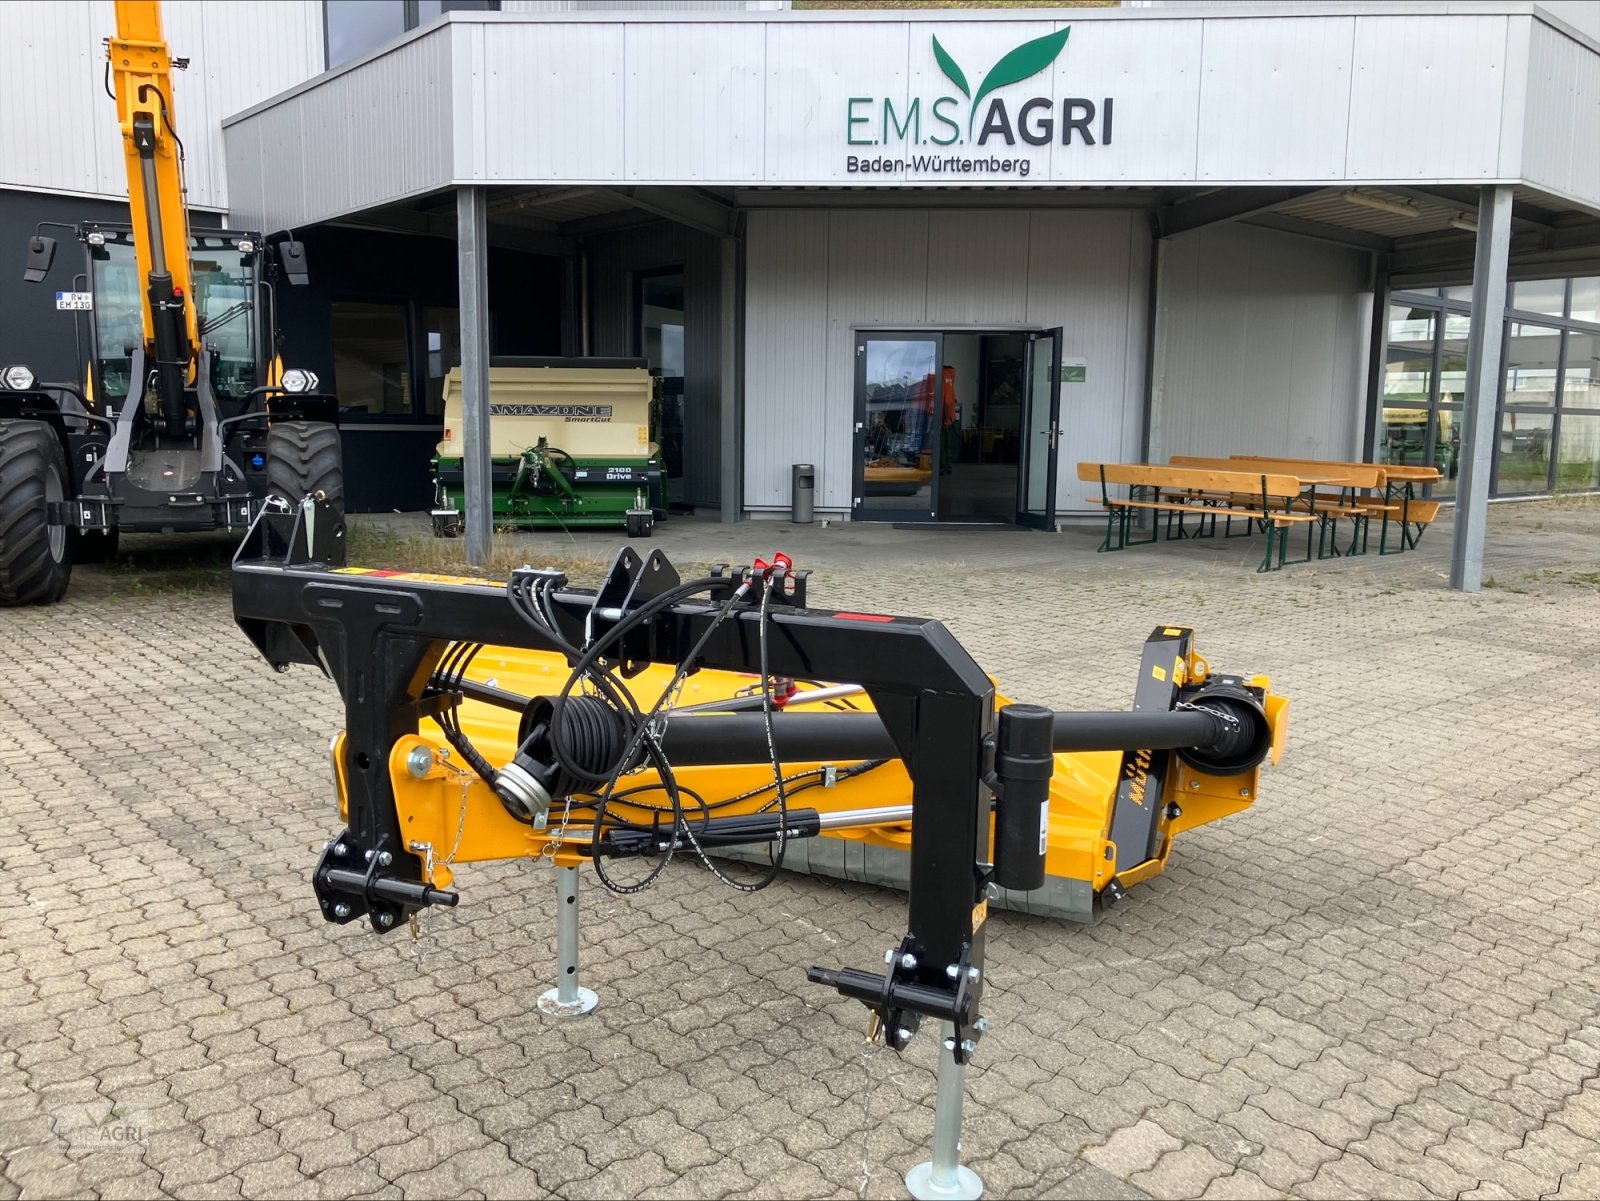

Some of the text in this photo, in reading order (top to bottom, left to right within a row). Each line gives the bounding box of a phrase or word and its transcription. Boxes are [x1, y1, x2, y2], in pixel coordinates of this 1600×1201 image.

[847, 97, 1114, 146] E.M.S. AGRI
[846, 155, 1031, 176] Baden-Württemberg
[71, 293, 82, 301] RW
[74, 301, 91, 309] 130
[490, 405, 612, 416] AMAZONE
